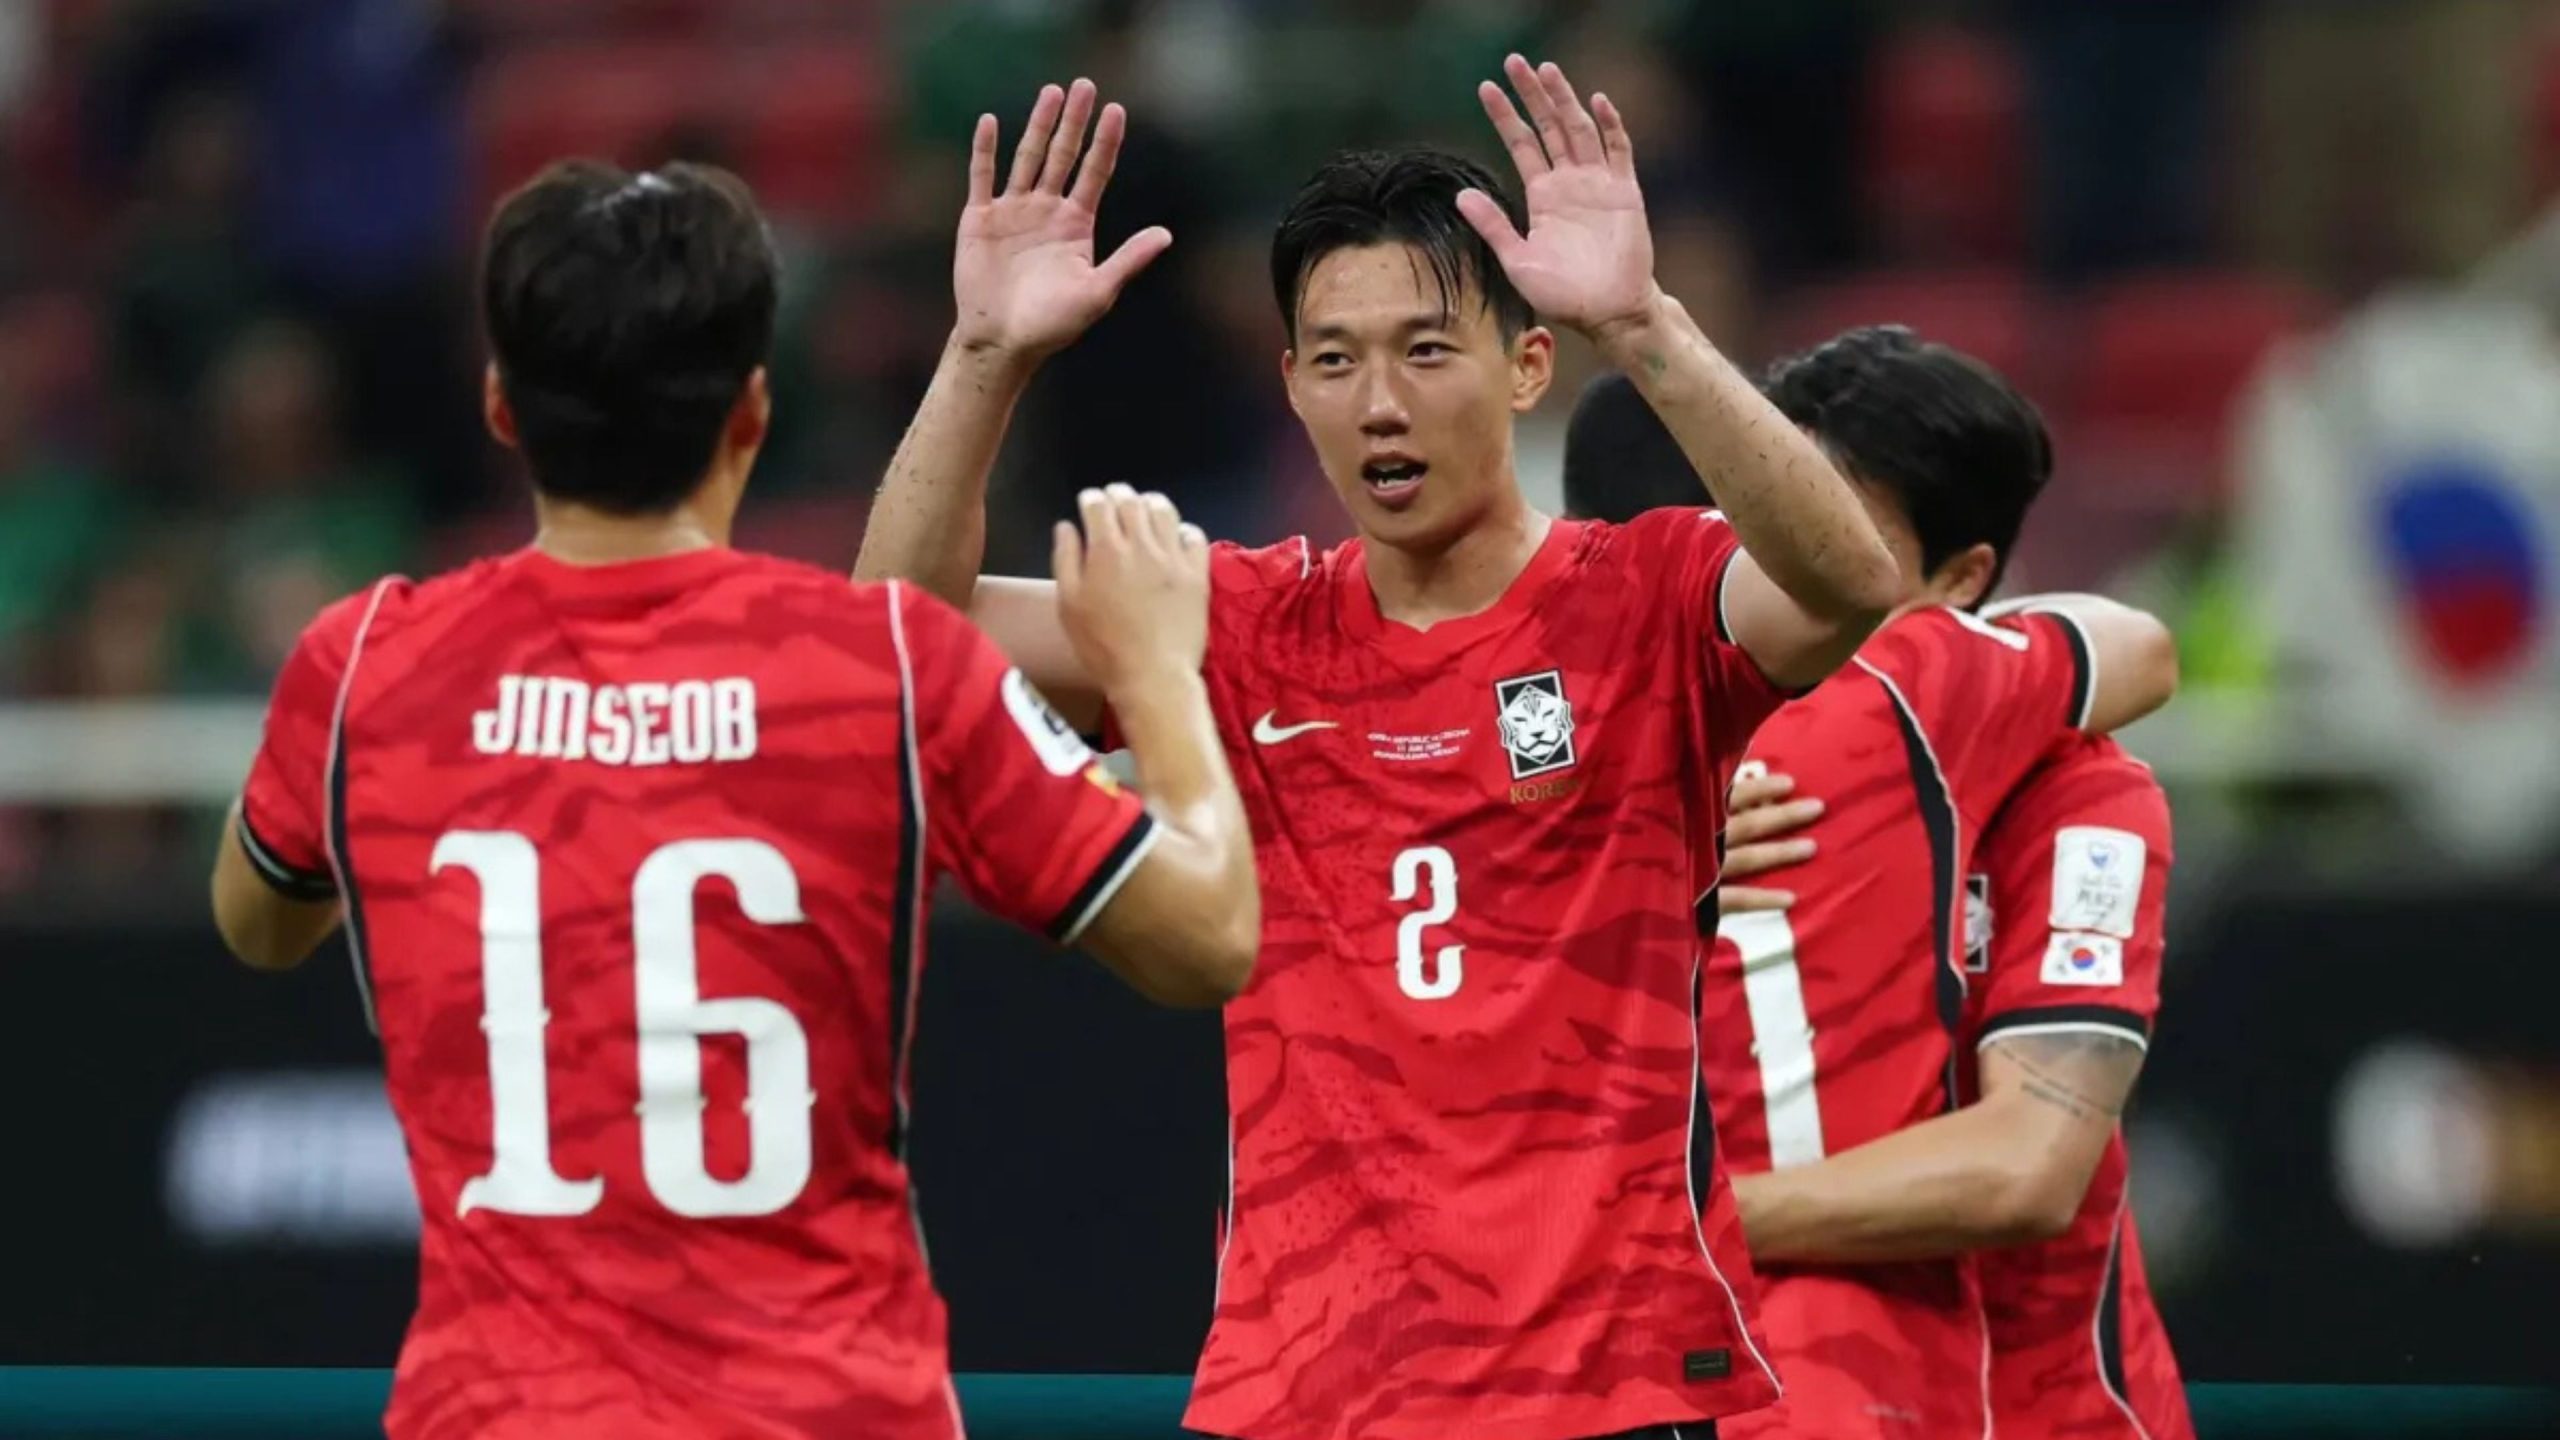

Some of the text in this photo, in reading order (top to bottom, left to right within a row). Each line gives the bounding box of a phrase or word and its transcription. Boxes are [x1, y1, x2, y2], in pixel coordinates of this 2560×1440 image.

[472, 674, 759, 766] JINSEOB
[1388, 845, 1467, 1000] 2
[429, 831, 816, 1219] 16
